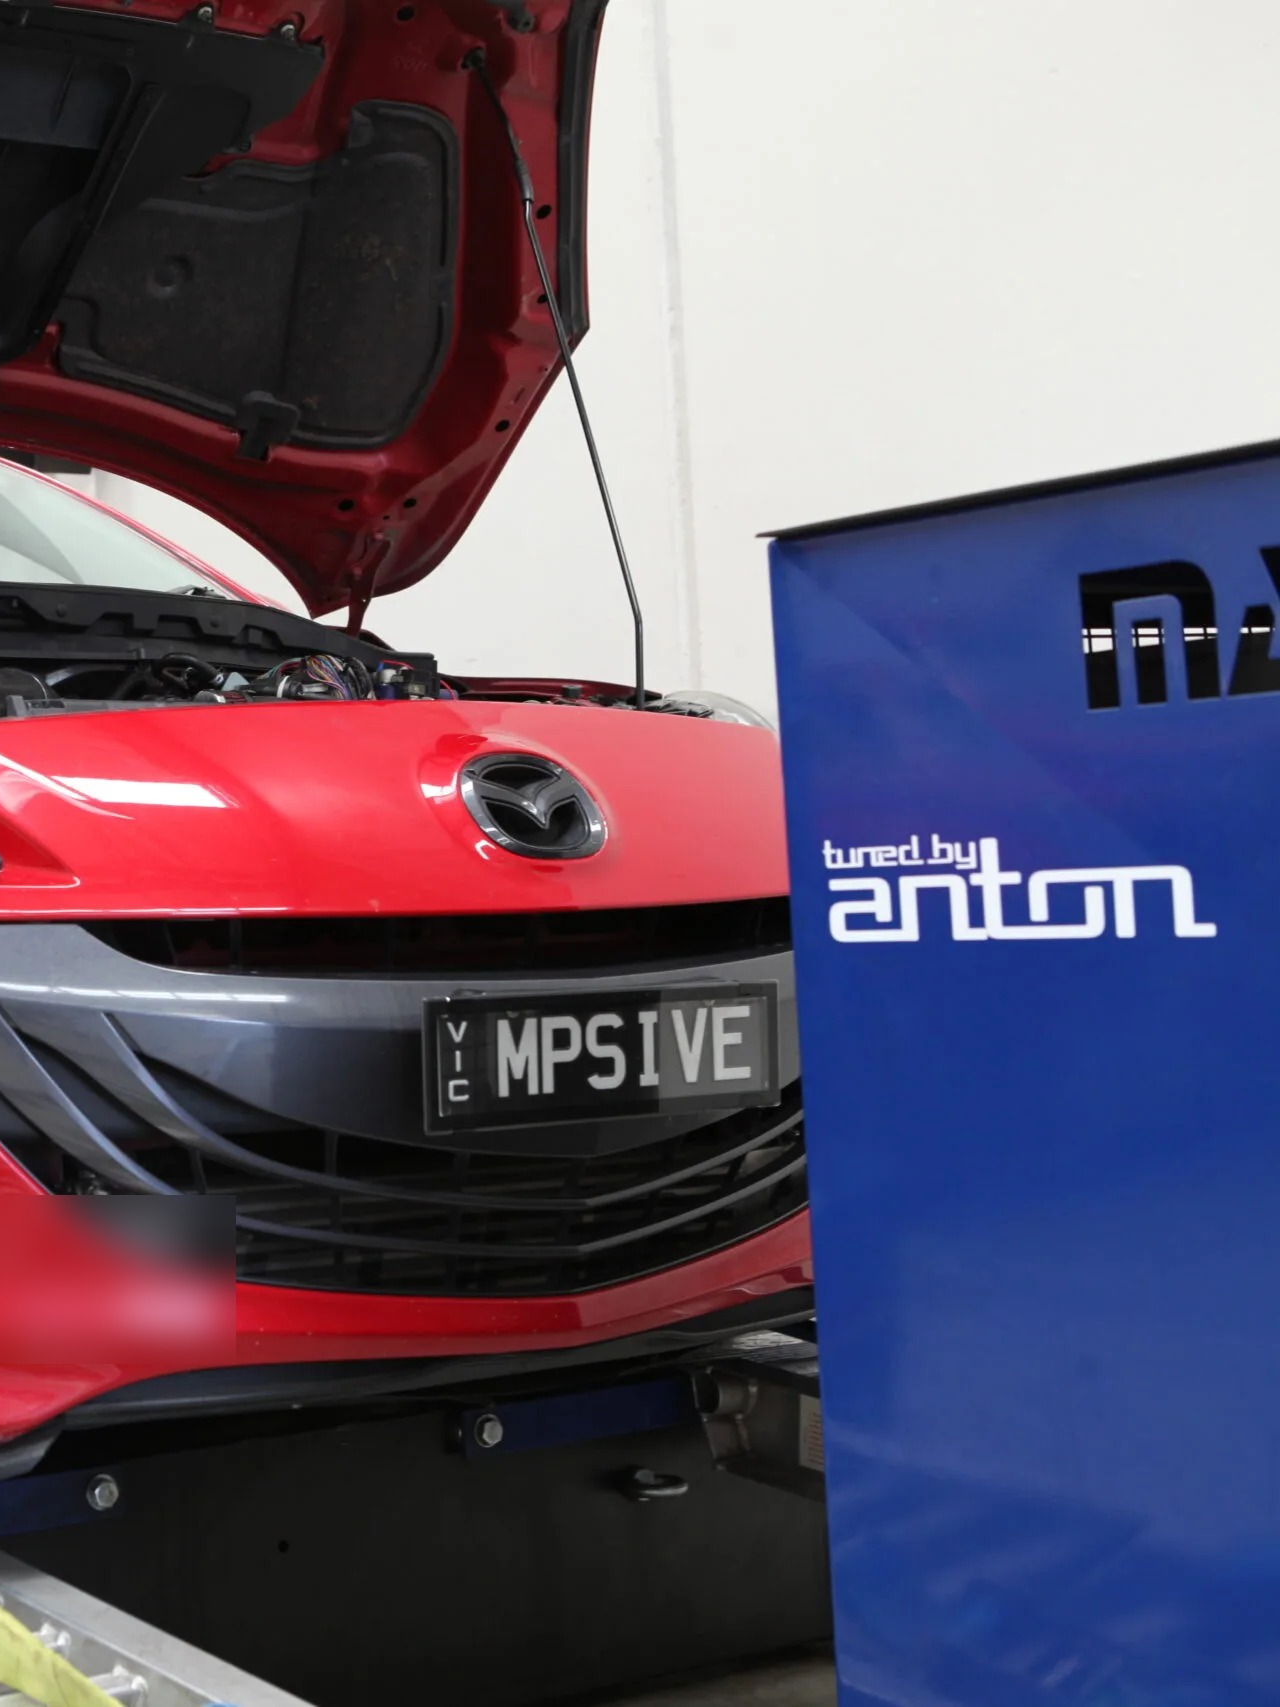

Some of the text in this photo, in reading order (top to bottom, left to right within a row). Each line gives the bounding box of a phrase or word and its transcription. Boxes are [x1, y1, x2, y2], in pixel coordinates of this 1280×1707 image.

[822, 834, 977, 870] tuned by
[829, 838, 1217, 942] anton
[447, 1021, 469, 1102] VIC
[497, 1005, 752, 1098] MPSIVE
